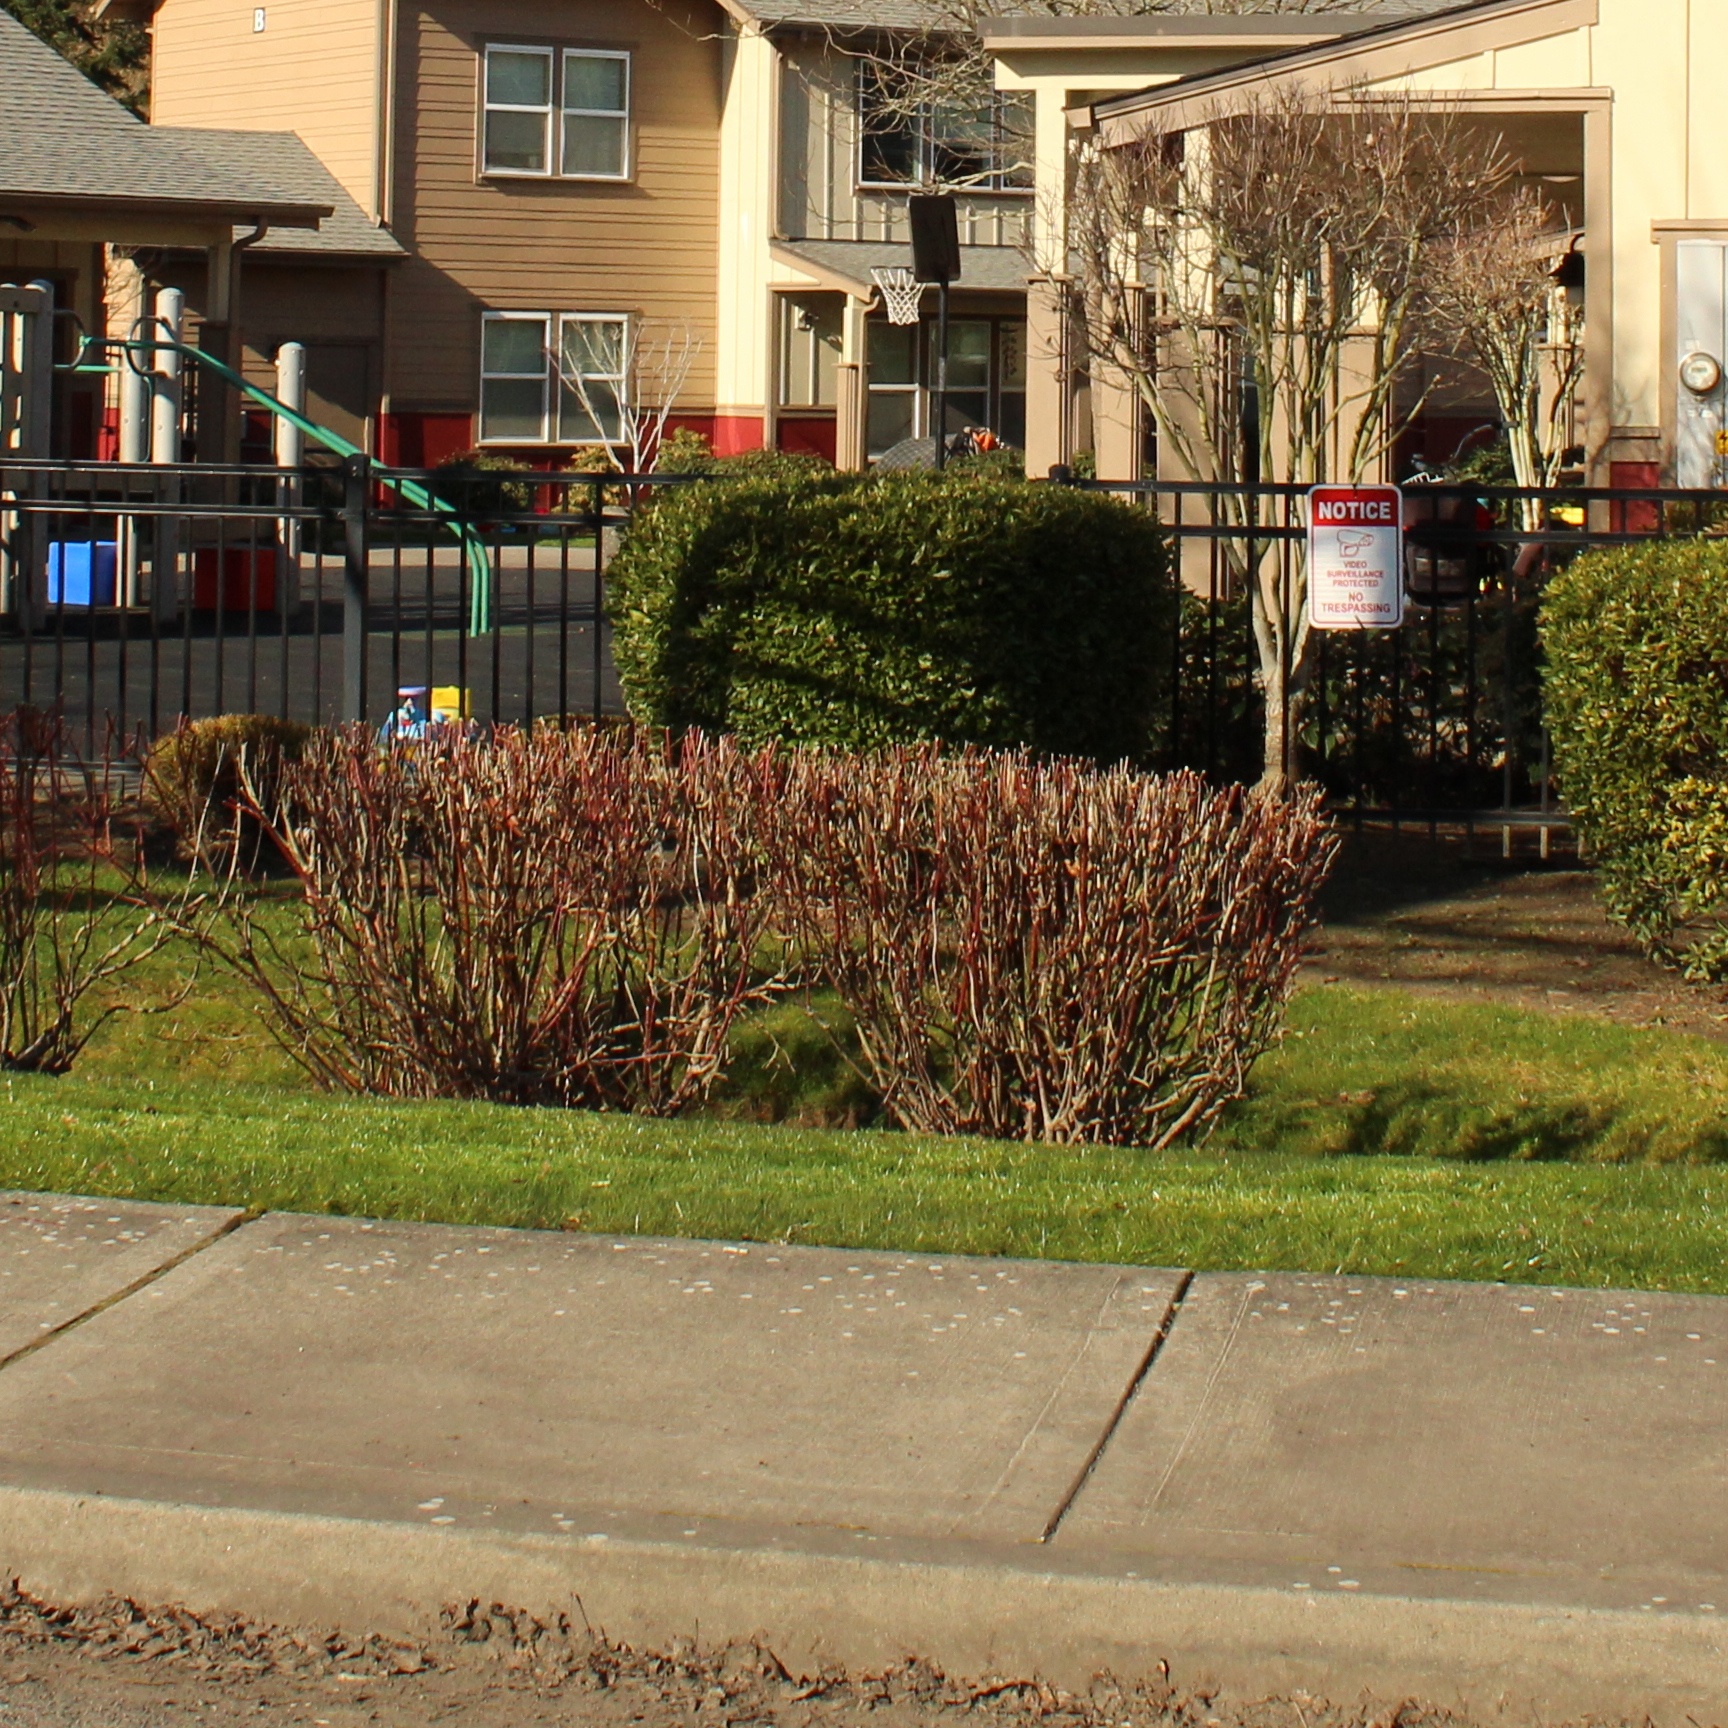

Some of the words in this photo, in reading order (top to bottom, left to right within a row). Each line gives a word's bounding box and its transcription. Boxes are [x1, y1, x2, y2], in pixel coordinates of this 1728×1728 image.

[253, 9, 264, 32] B
[1318, 501, 1391, 520] NOTICE
[1327, 570, 1384, 578] SURVEILLANCE
[1332, 579, 1379, 587] PROTECTED
[1348, 592, 1364, 602] NO
[1322, 603, 1391, 613] TRESPASSING
